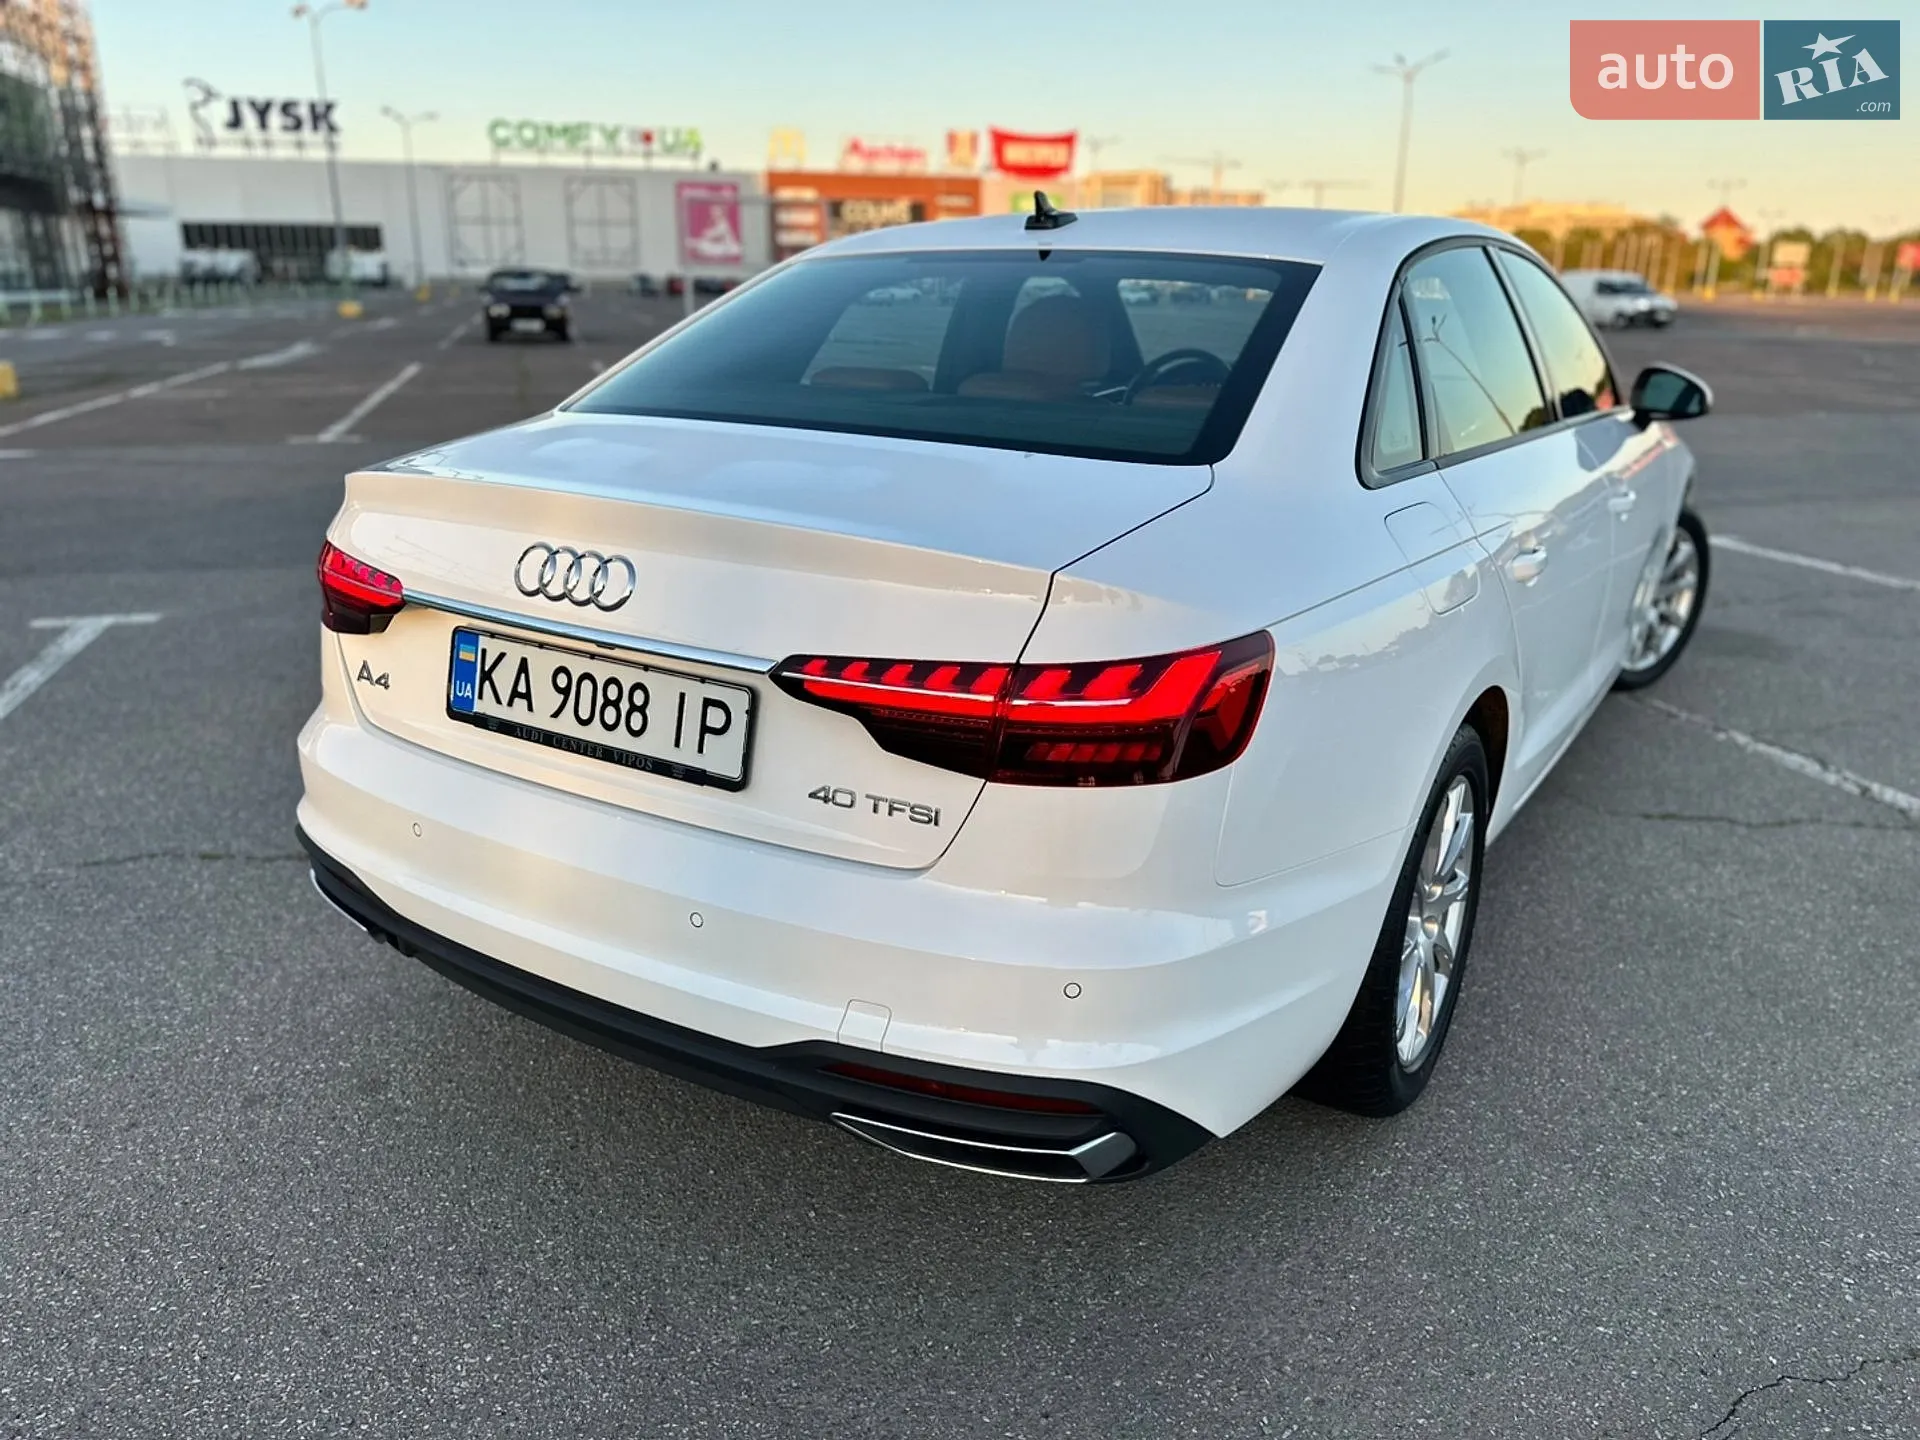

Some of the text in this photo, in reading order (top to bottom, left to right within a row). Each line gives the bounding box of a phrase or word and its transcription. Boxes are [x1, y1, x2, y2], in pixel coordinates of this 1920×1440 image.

[224, 100, 342, 133] JYSK
[488, 118, 623, 148] COMFY
[357, 659, 391, 690] A4
[455, 680, 473, 699] UA
[478, 647, 733, 755] KA 9088 IP
[514, 727, 654, 771] AUDI CENTER VIPOS
[808, 784, 941, 827] 40 TFSI
